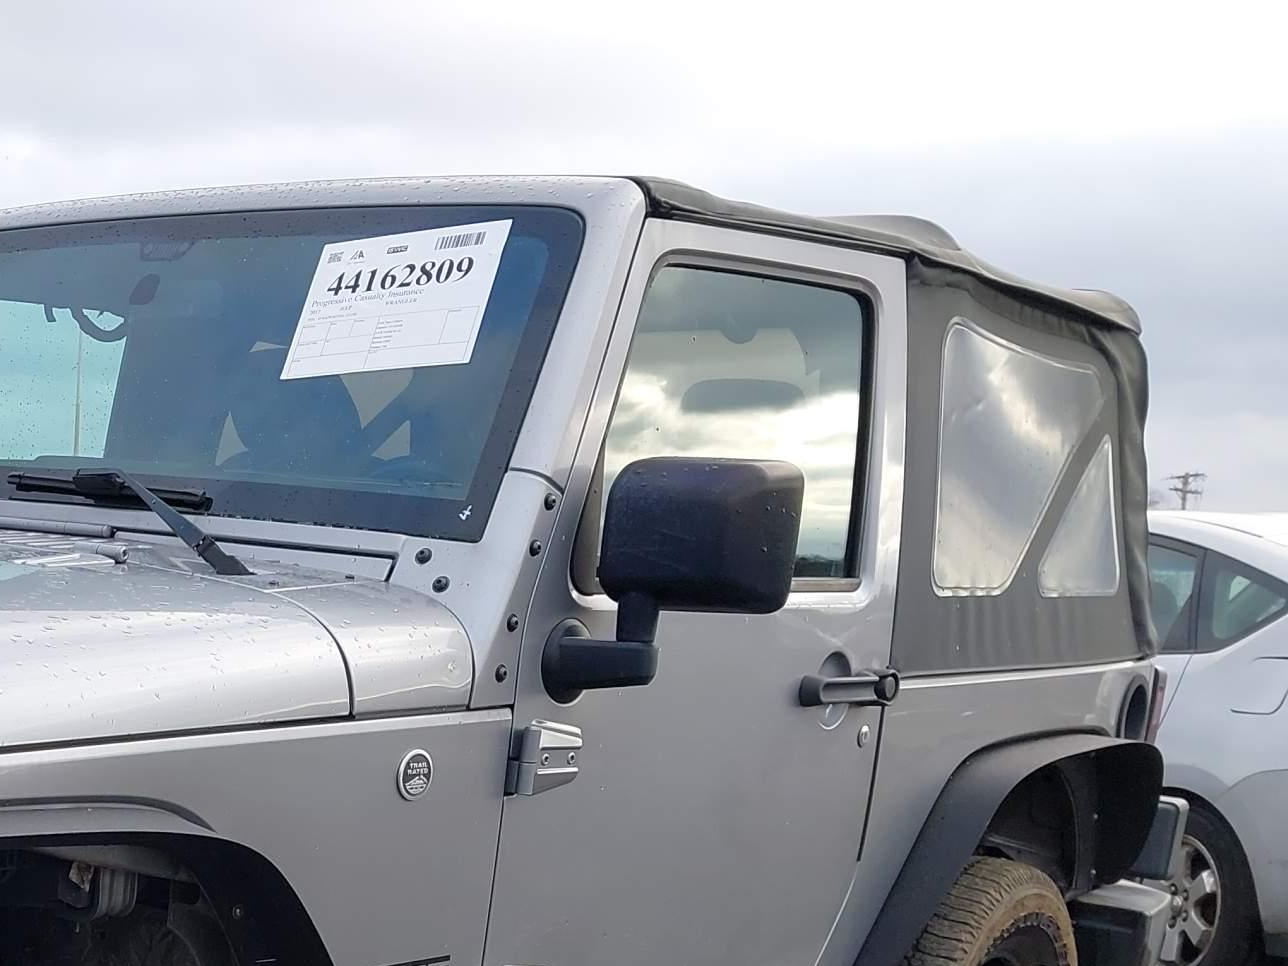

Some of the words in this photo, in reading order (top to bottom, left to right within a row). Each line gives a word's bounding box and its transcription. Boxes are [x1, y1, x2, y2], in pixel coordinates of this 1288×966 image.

[326, 256, 475, 297] 44162809
[311, 296, 353, 308] Progressive
[354, 290, 385, 302] Casualty
[387, 288, 425, 299] Insurance
[409, 761, 428, 769] TRAIL
